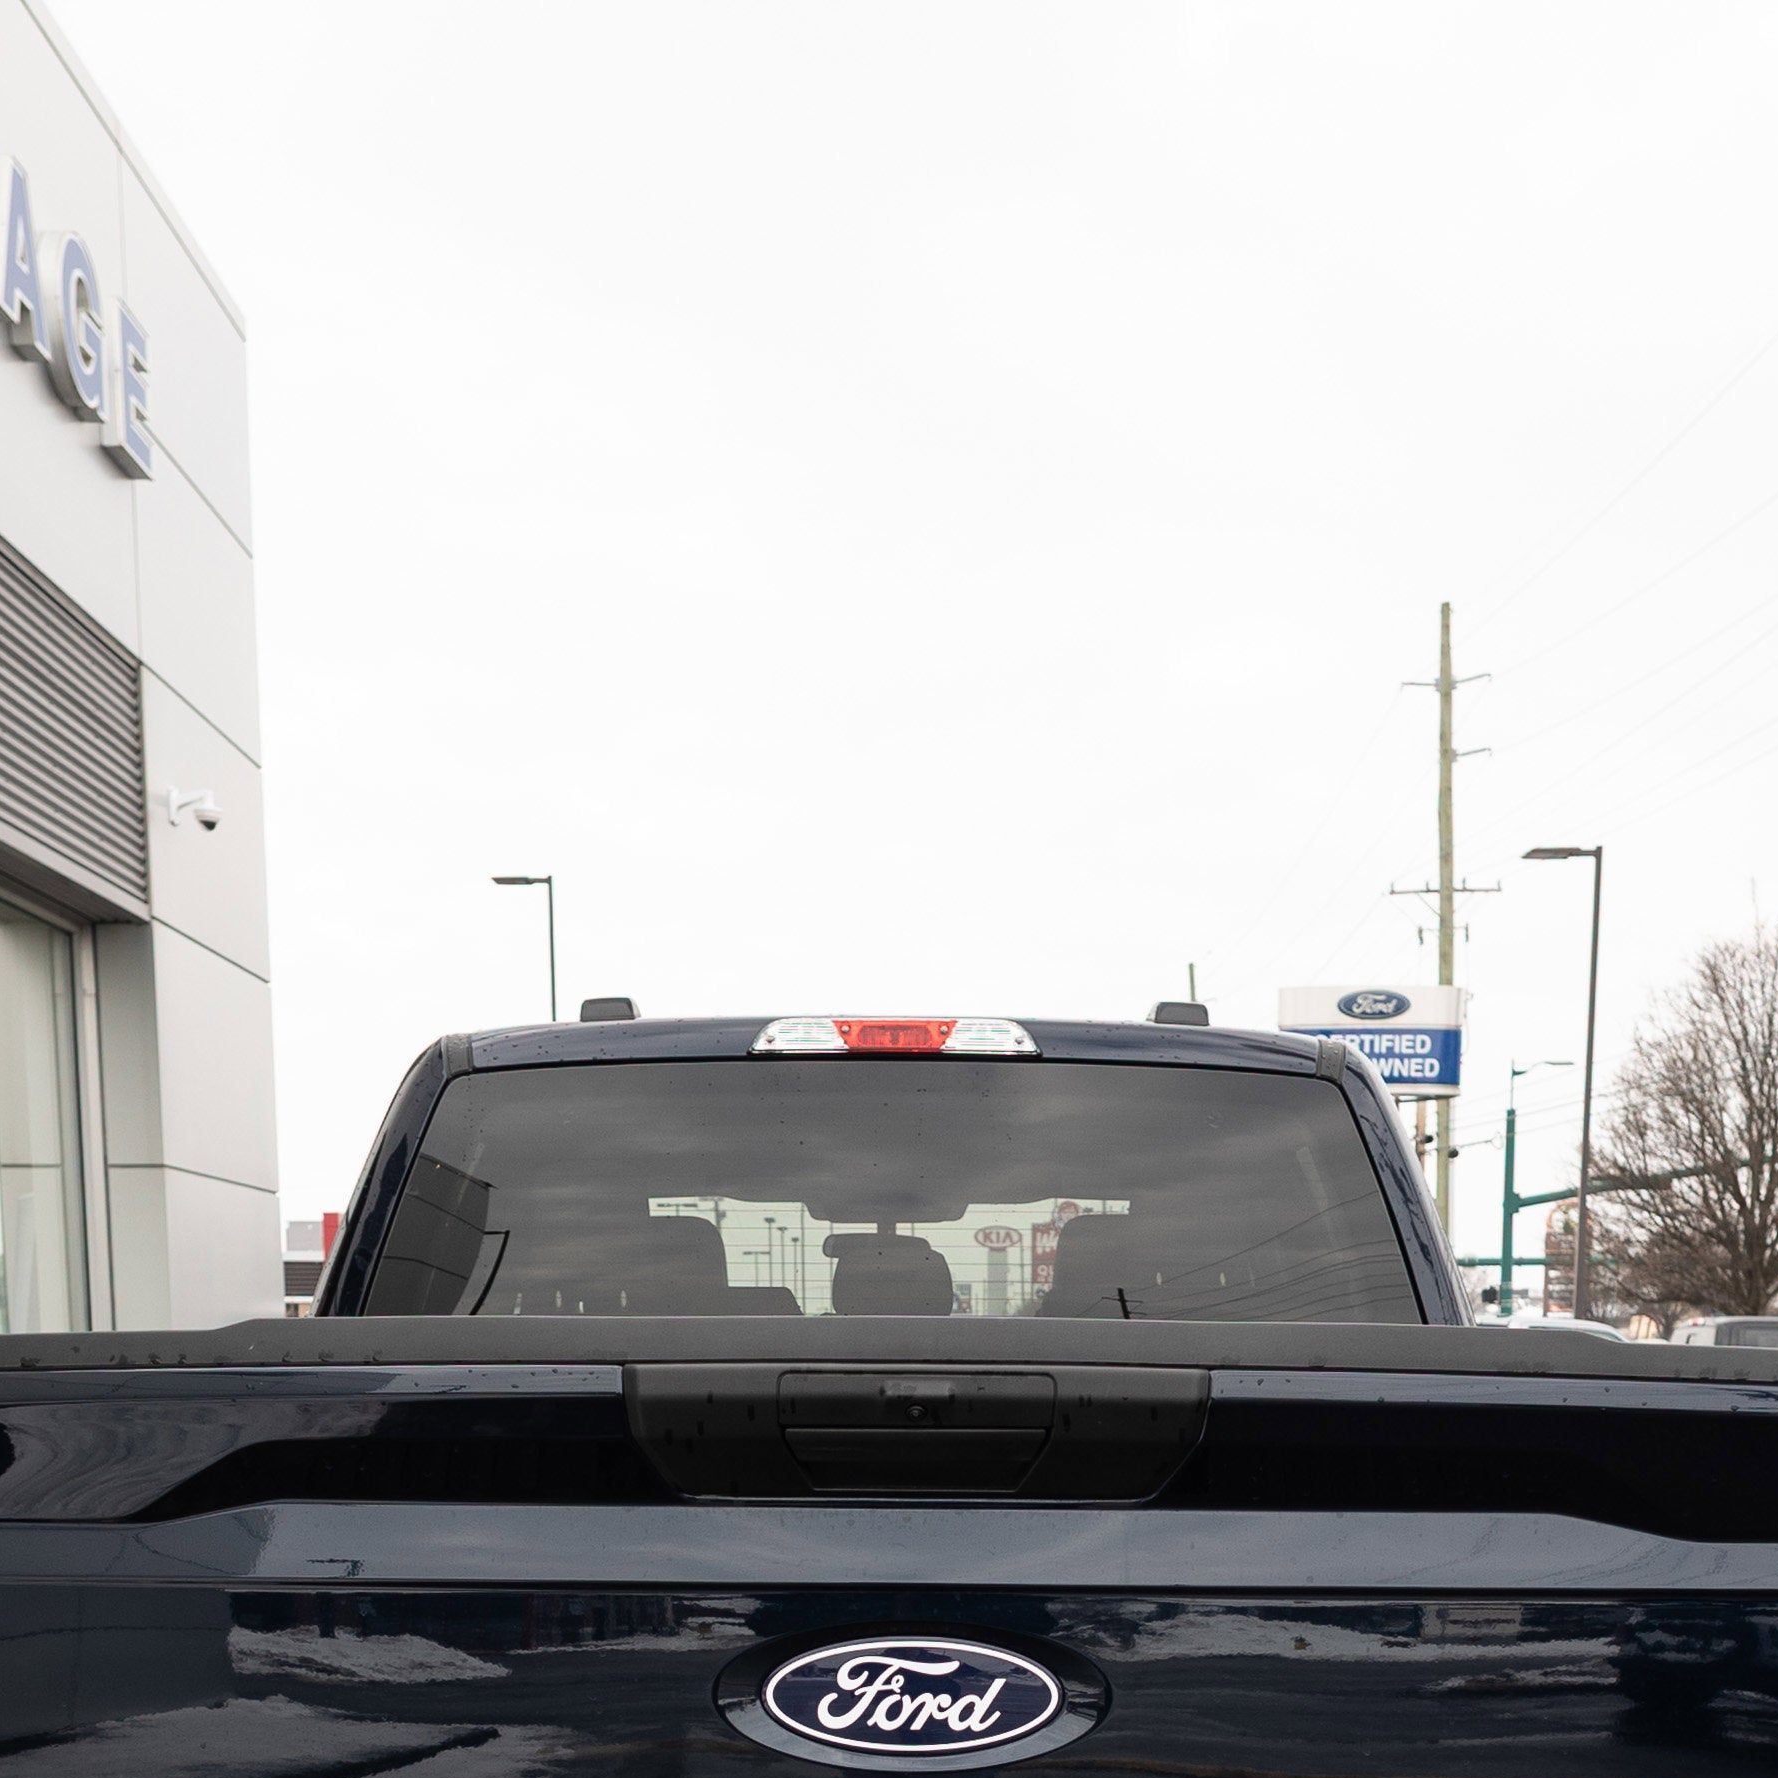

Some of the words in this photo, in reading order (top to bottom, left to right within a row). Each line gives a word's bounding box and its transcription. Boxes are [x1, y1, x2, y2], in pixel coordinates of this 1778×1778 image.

[1351, 993, 1398, 1014] Ford
[982, 1230, 1015, 1244] KIA
[817, 1655, 1007, 1731] Ford
